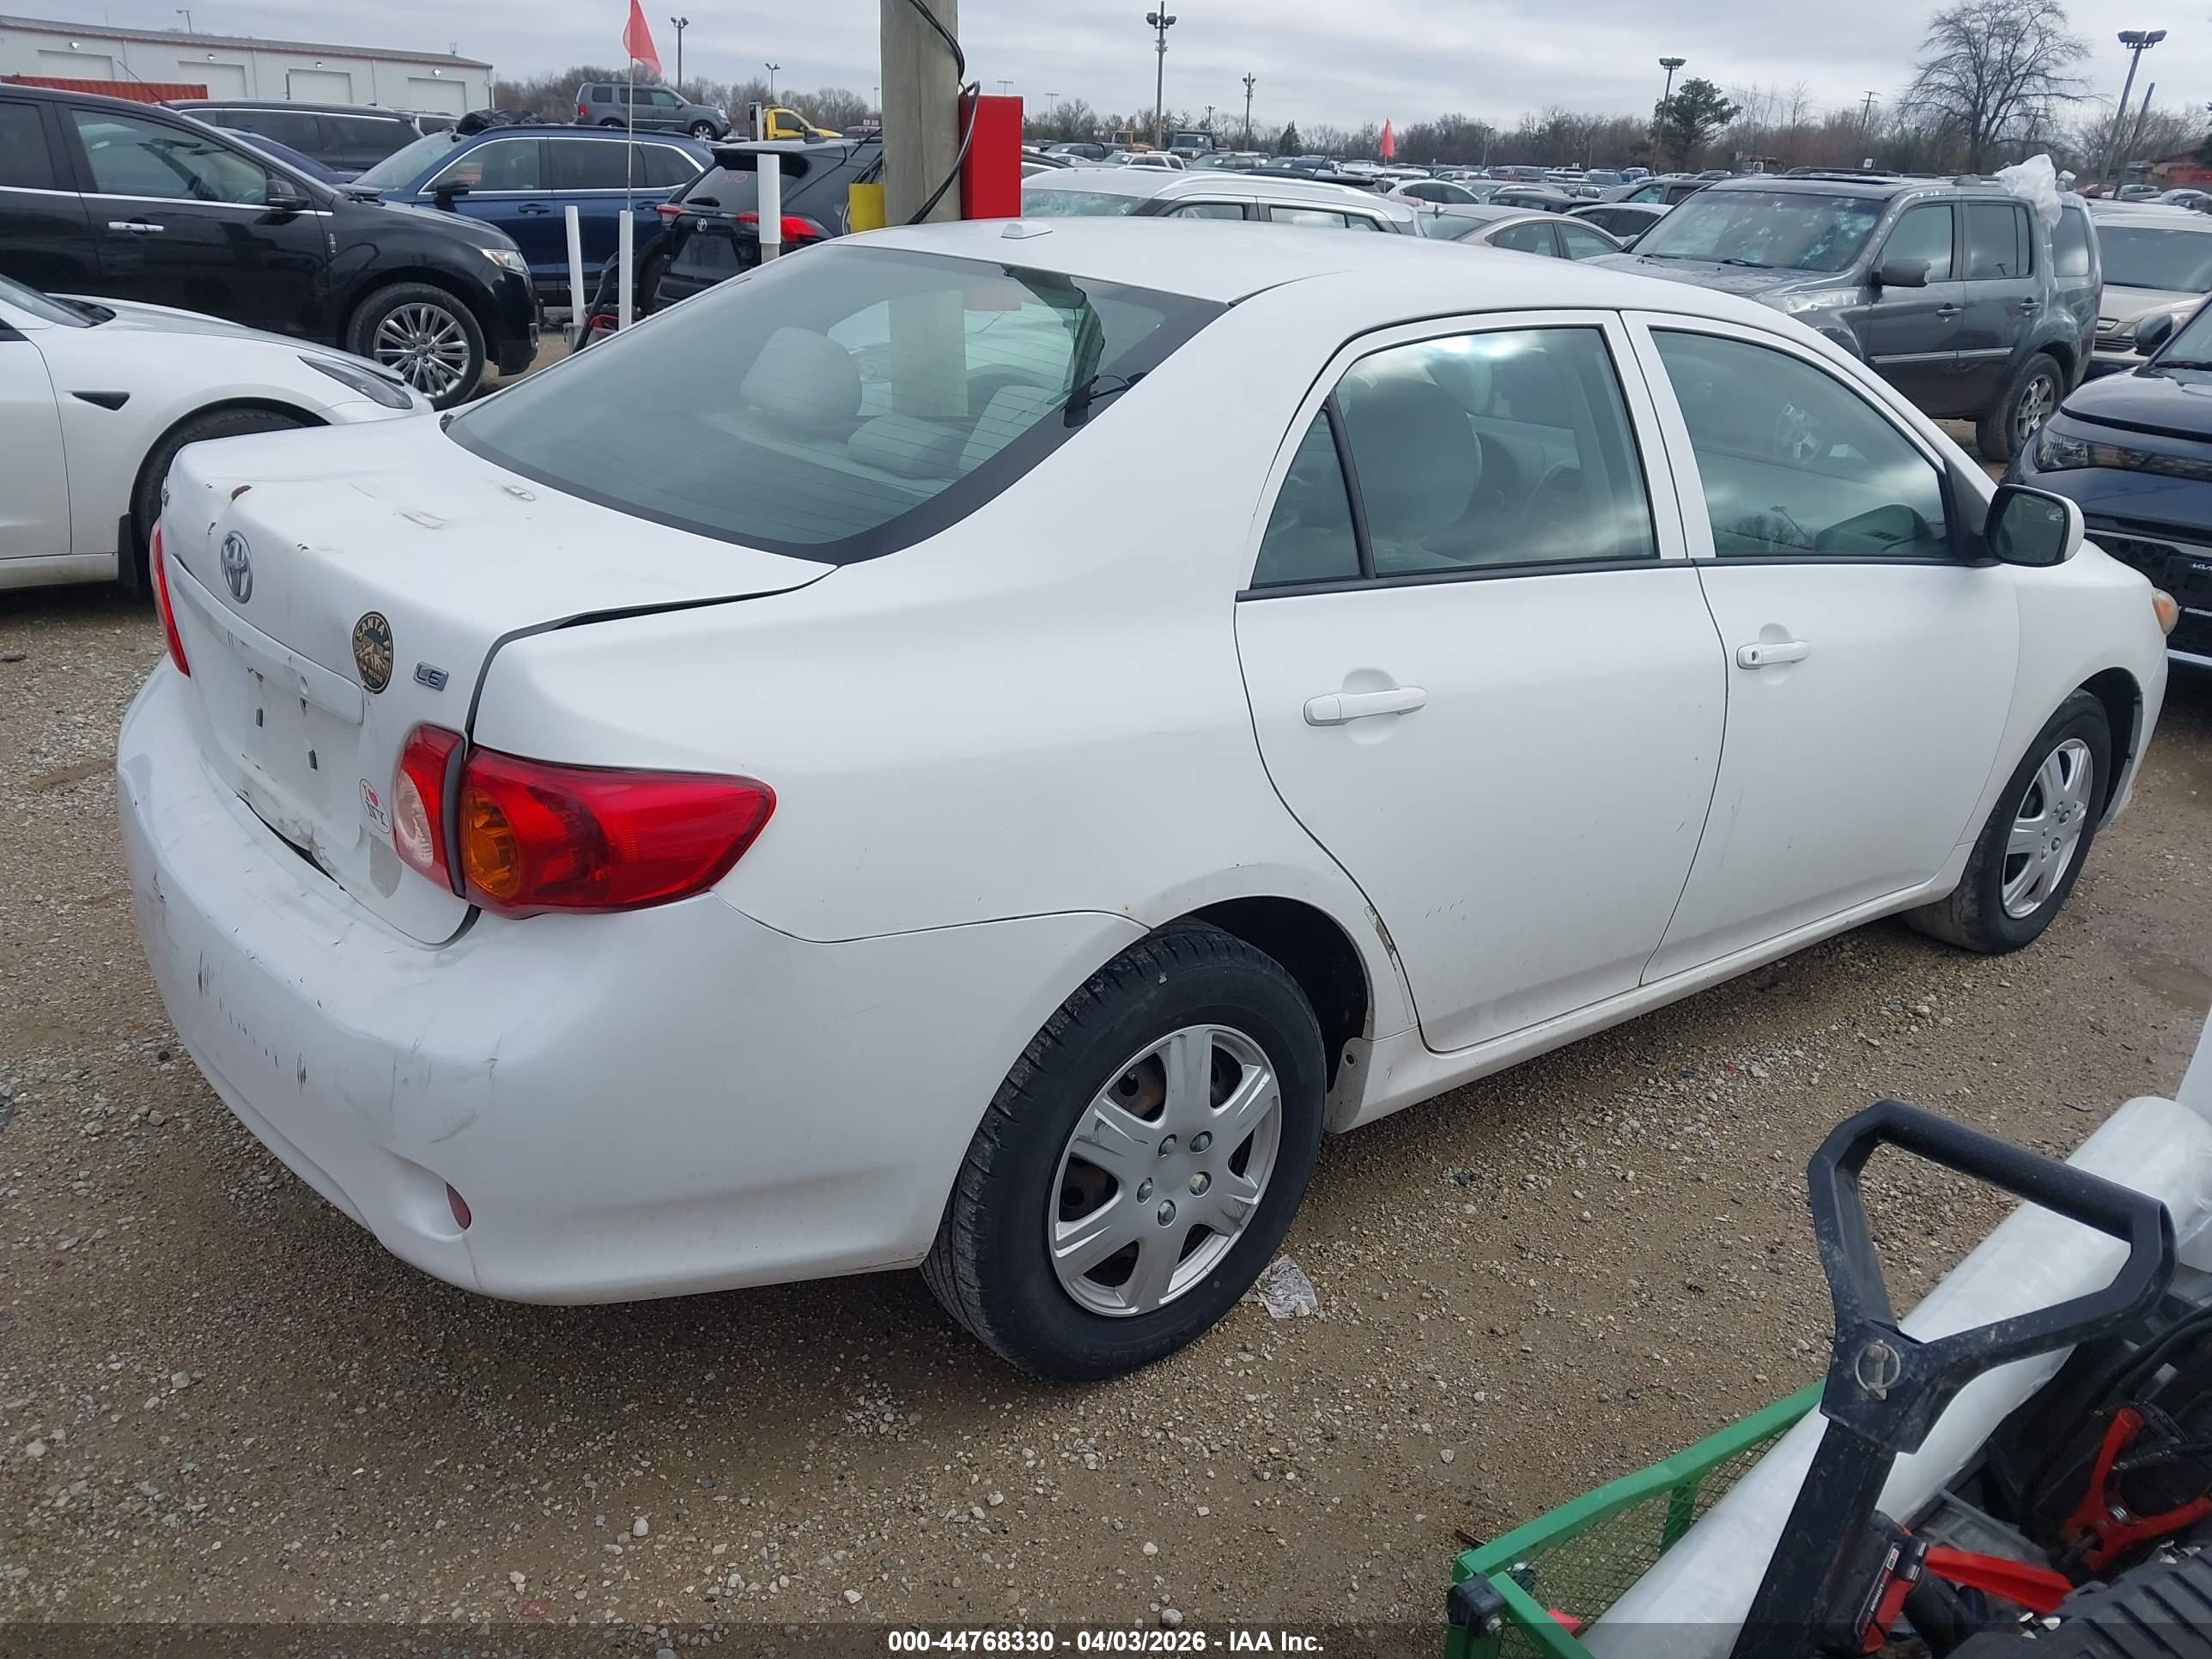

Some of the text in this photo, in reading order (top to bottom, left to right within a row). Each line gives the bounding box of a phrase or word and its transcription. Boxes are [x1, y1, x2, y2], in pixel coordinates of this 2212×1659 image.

[356, 617, 385, 641] SANTA
[383, 640, 392, 658] FE
[416, 665, 442, 687] LE
[365, 800, 389, 828] NY
